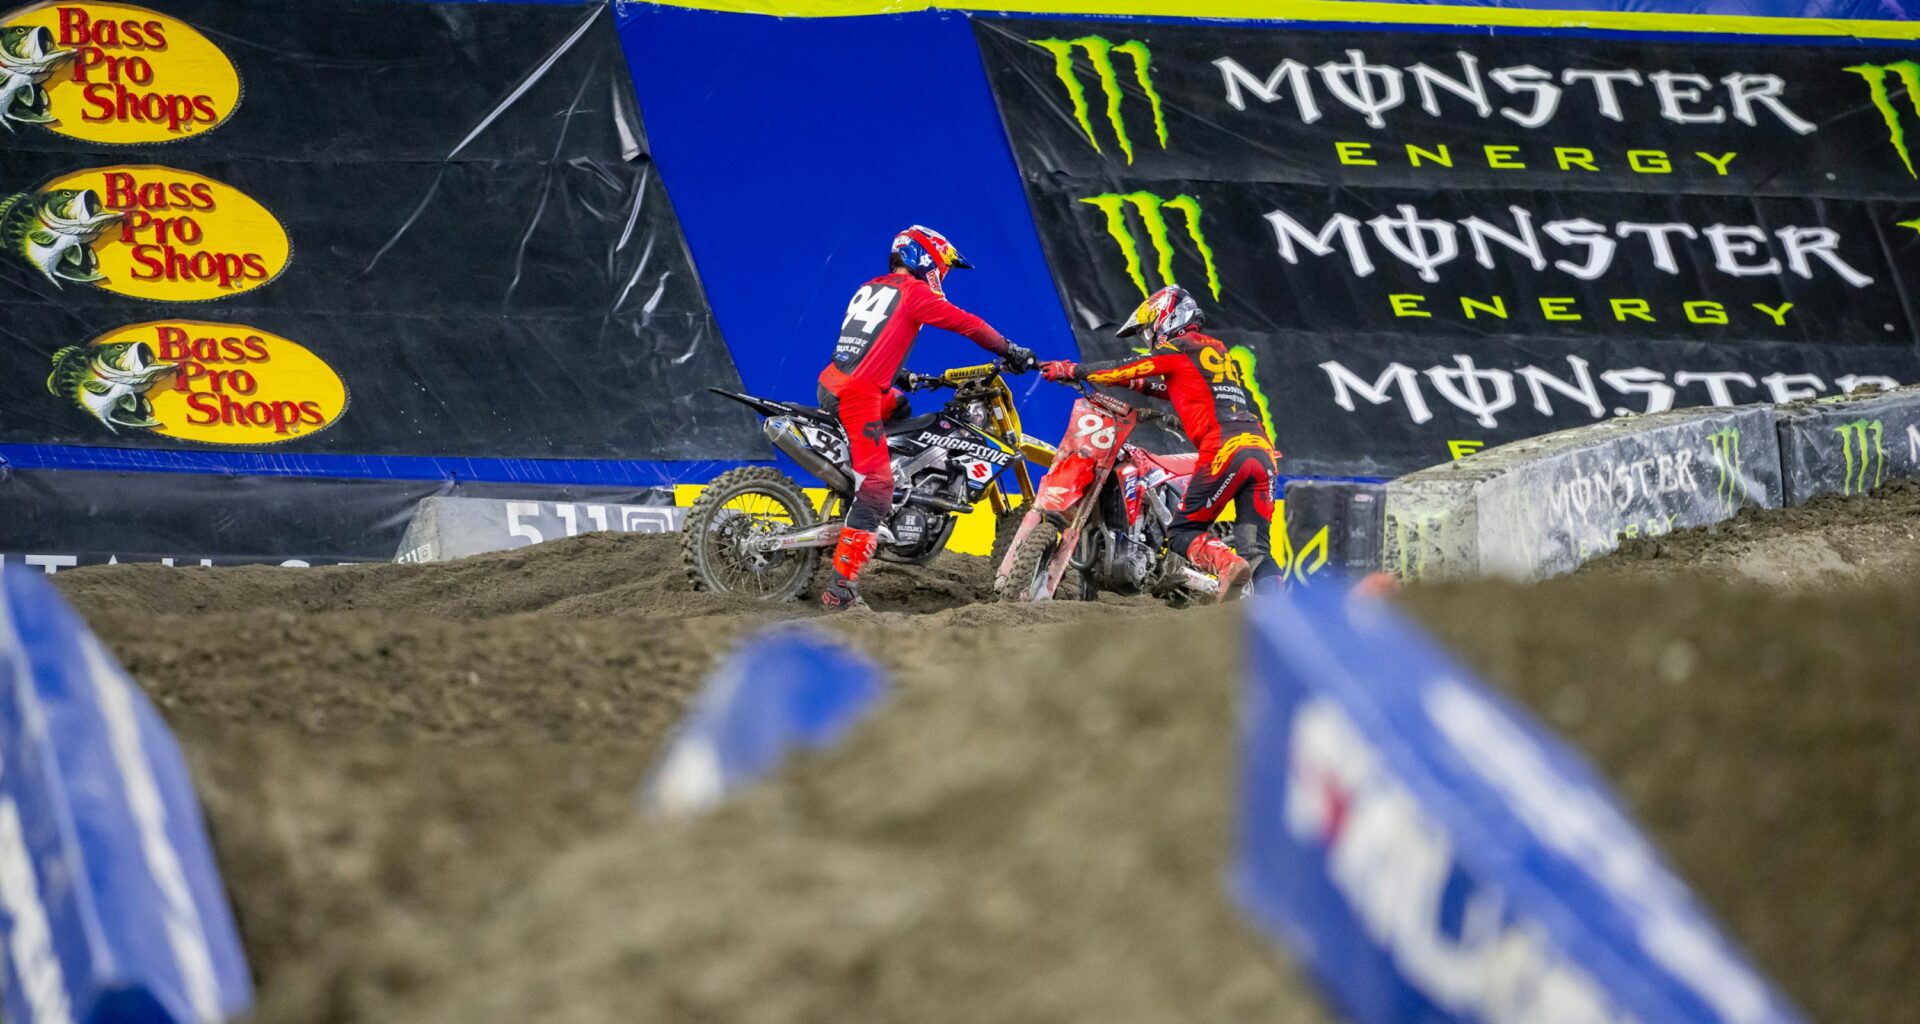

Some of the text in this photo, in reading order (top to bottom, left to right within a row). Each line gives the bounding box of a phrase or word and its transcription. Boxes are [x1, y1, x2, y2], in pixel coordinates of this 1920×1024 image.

[57, 7, 167, 50] Bass
[72, 47, 153, 84] Pro
[82, 83, 217, 131] Shops
[1211, 49, 1817, 134] MONSTER
[1334, 141, 1738, 176] ENERGY
[103, 172, 215, 210] Bass
[120, 209, 202, 245] Pro
[1263, 204, 1874, 288] MONSTER
[131, 245, 268, 288] Shops
[841, 285, 898, 334] 94
[1388, 293, 1794, 326] ENERGY
[155, 326, 268, 361] Bass
[174, 360, 256, 395] Pro
[1318, 354, 1900, 428] MONSTE
[186, 393, 324, 434] Shops
[1075, 414, 1115, 449] 96
[918, 431, 1011, 466] PROGRESSIVE
[1211, 472, 1236, 502] HONDA
